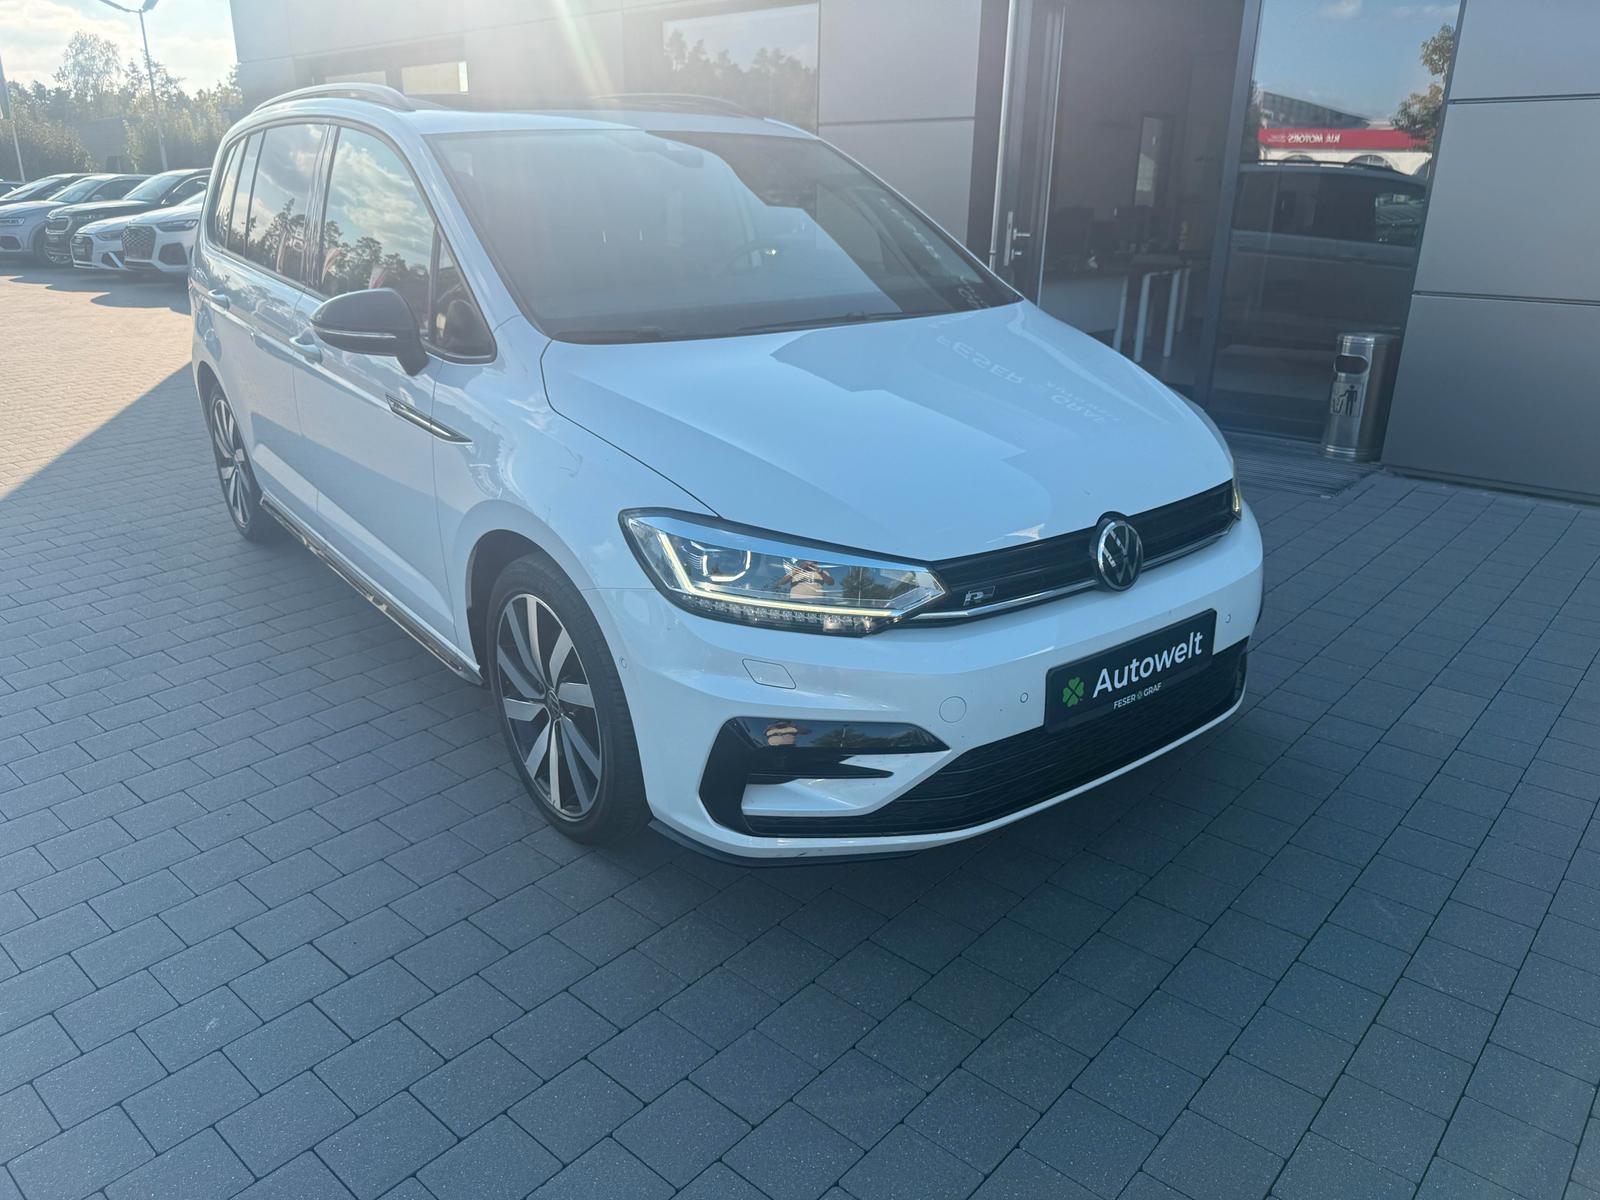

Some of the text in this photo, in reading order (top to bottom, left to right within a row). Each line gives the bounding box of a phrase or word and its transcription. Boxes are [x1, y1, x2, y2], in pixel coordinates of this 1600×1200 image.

[1092, 631, 1203, 698] Autowelt
[1113, 682, 1162, 710] FESER GRAF
